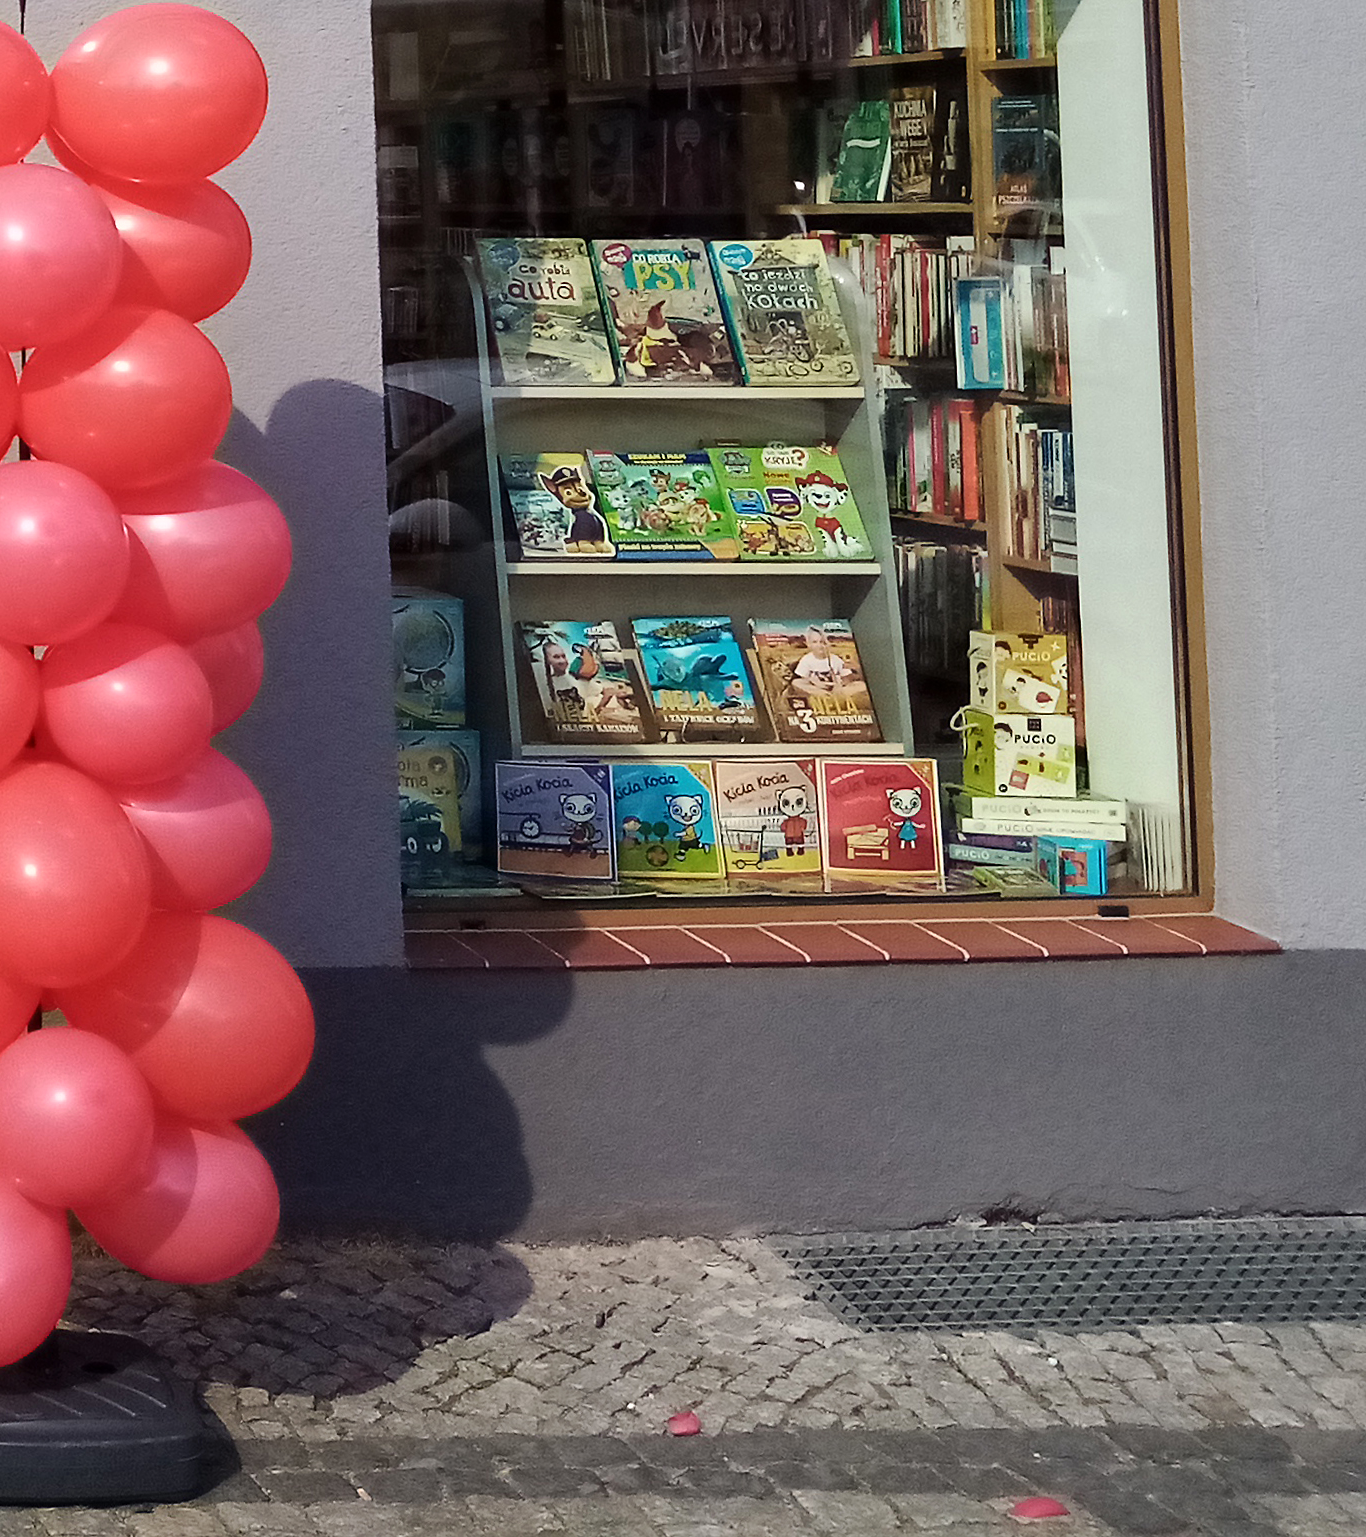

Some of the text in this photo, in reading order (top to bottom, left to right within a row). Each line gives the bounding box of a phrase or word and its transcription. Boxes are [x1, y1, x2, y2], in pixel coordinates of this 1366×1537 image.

[632, 263, 691, 291] PSY
[509, 278, 574, 301] auta
[660, 690, 714, 712] NELA
[810, 696, 859, 715] NELA
[796, 709, 817, 733] 3
[502, 776, 573, 803] Kicia Kocia
[643, 774, 679, 789] Kocia
[722, 773, 790, 802] Kicia Kocia
